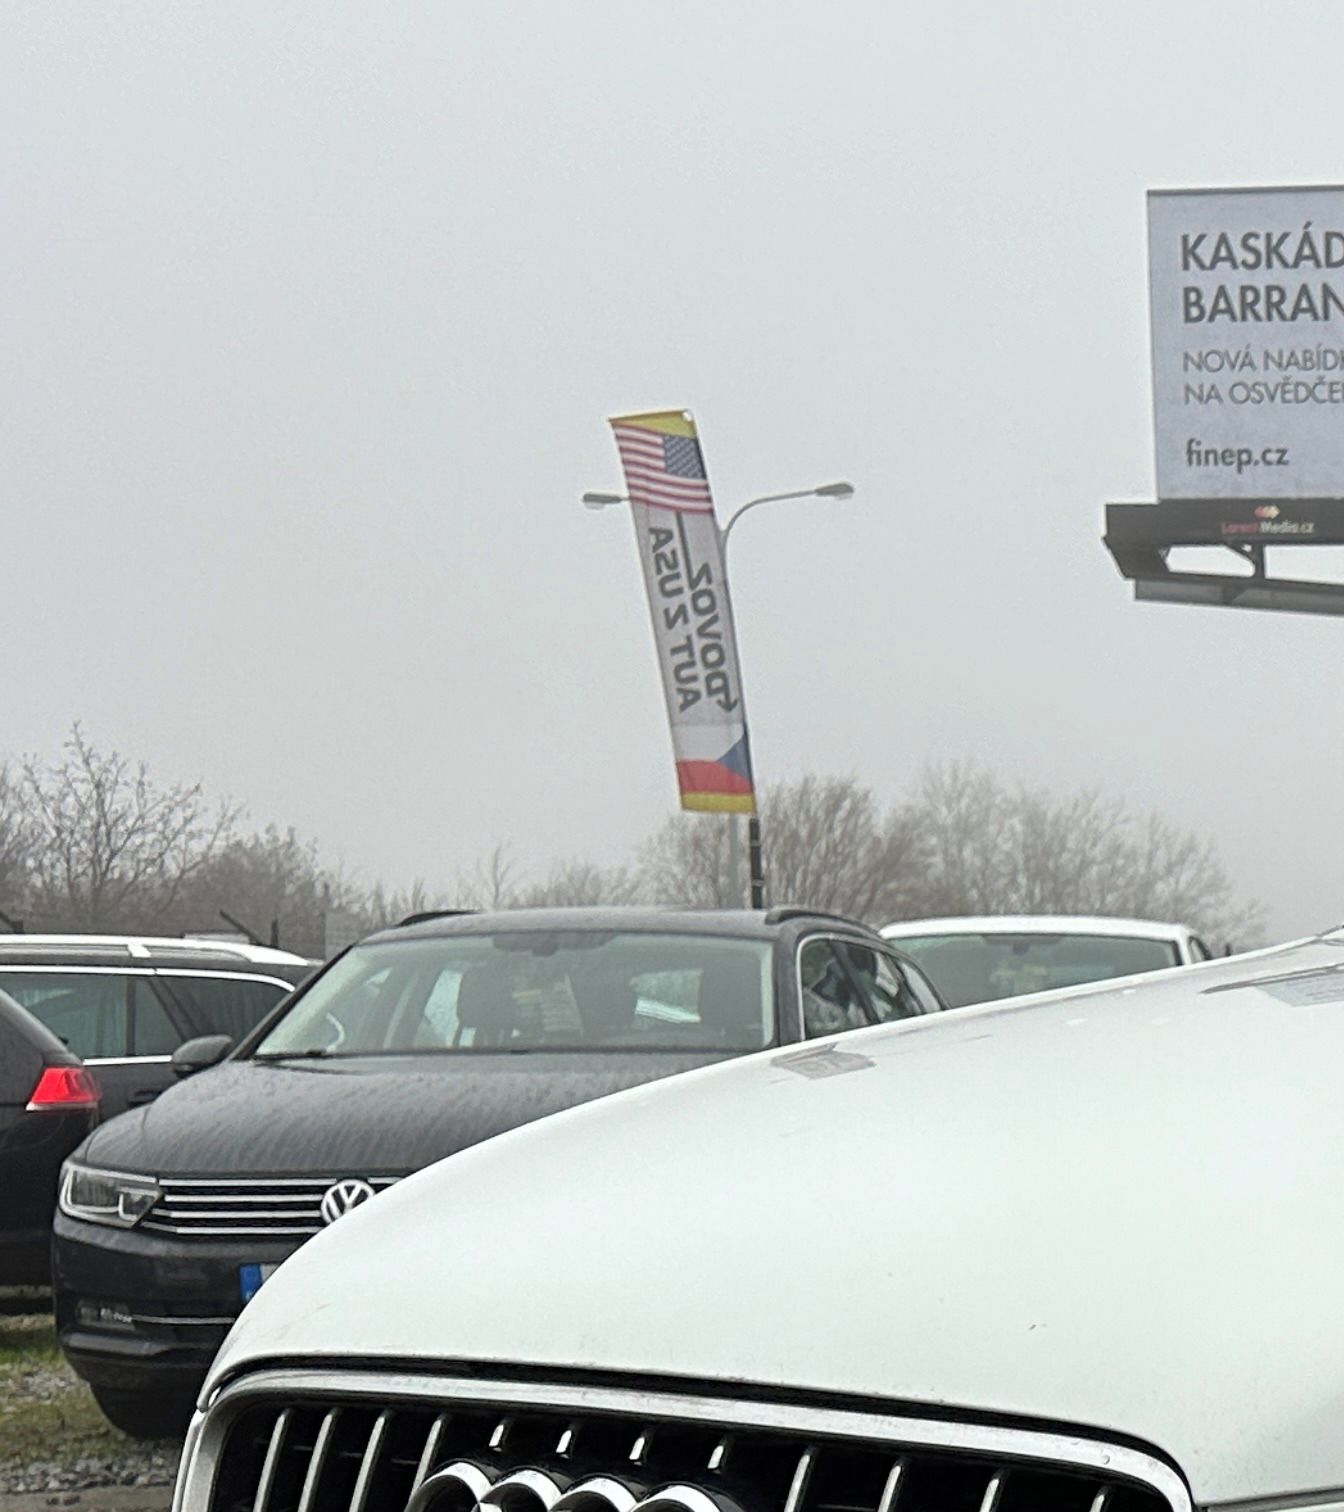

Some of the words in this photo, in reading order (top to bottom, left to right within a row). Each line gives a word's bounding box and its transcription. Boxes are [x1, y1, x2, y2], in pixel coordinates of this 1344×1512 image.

[1182, 343, 1257, 373] NOVÁ
[1184, 382, 1224, 405] NA
[1186, 438, 1290, 475] finep.cz
